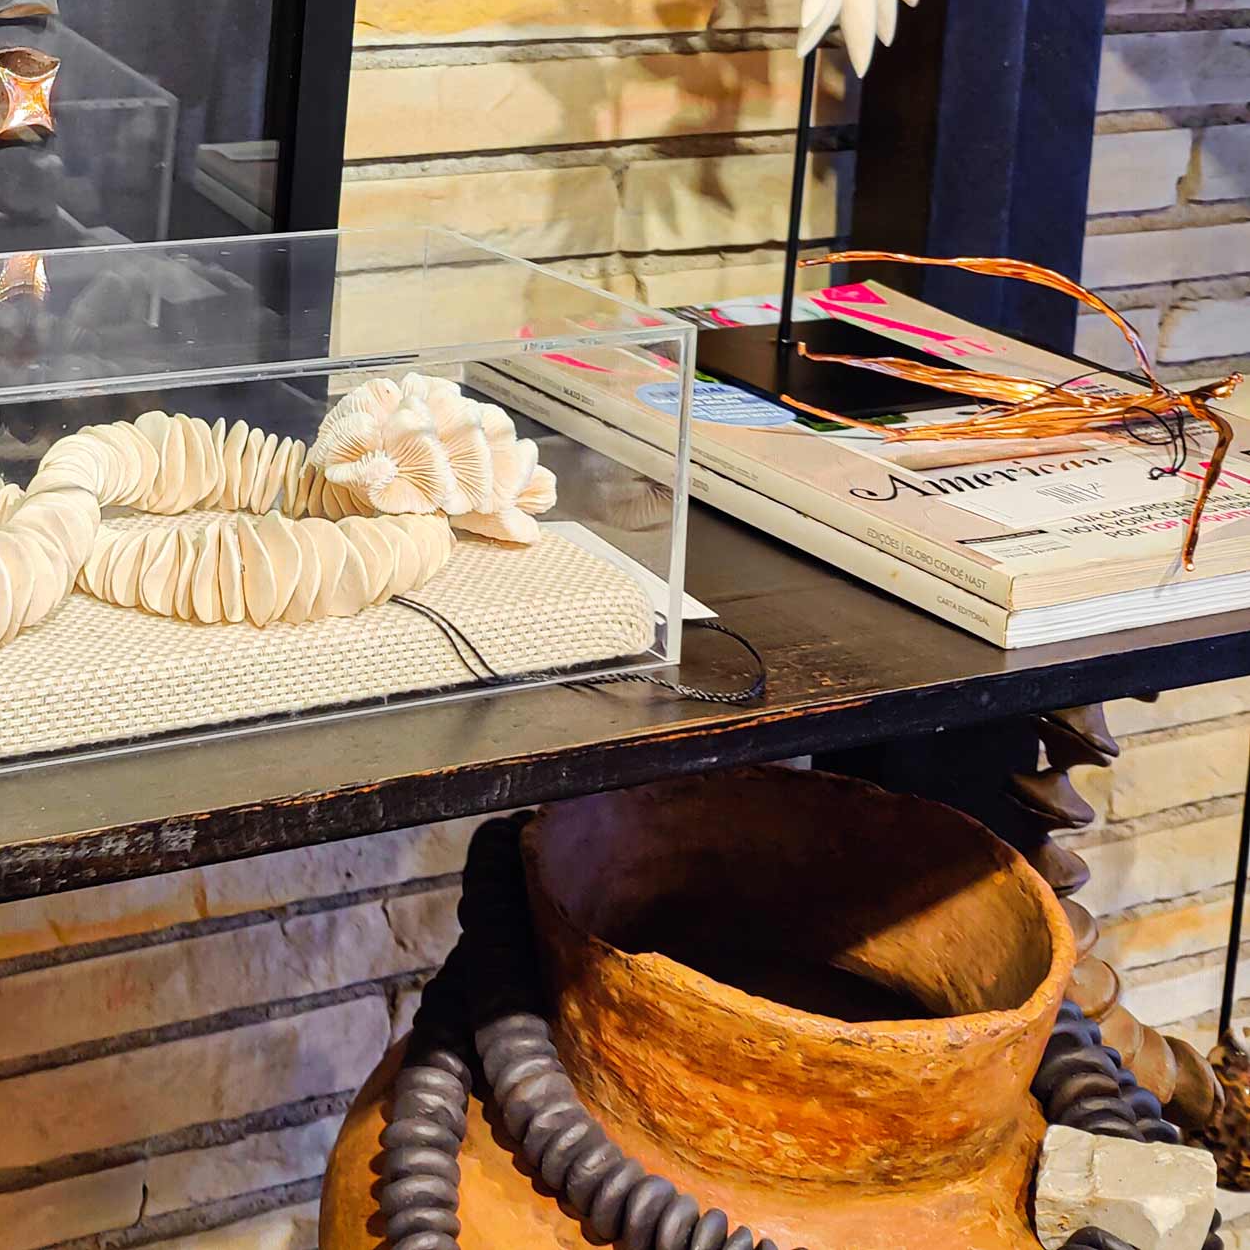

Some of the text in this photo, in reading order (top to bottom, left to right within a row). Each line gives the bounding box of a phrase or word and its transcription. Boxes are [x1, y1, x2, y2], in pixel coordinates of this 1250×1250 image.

[849, 456, 1113, 501] American
[1061, 521, 1112, 535] NOVA
[1104, 527, 1146, 539] POR
[1139, 519, 1180, 533] TOP
[866, 527, 987, 590] EDIÇÕES GLOBO CONDÉ NAST
[936, 595, 957, 610] CARTA
